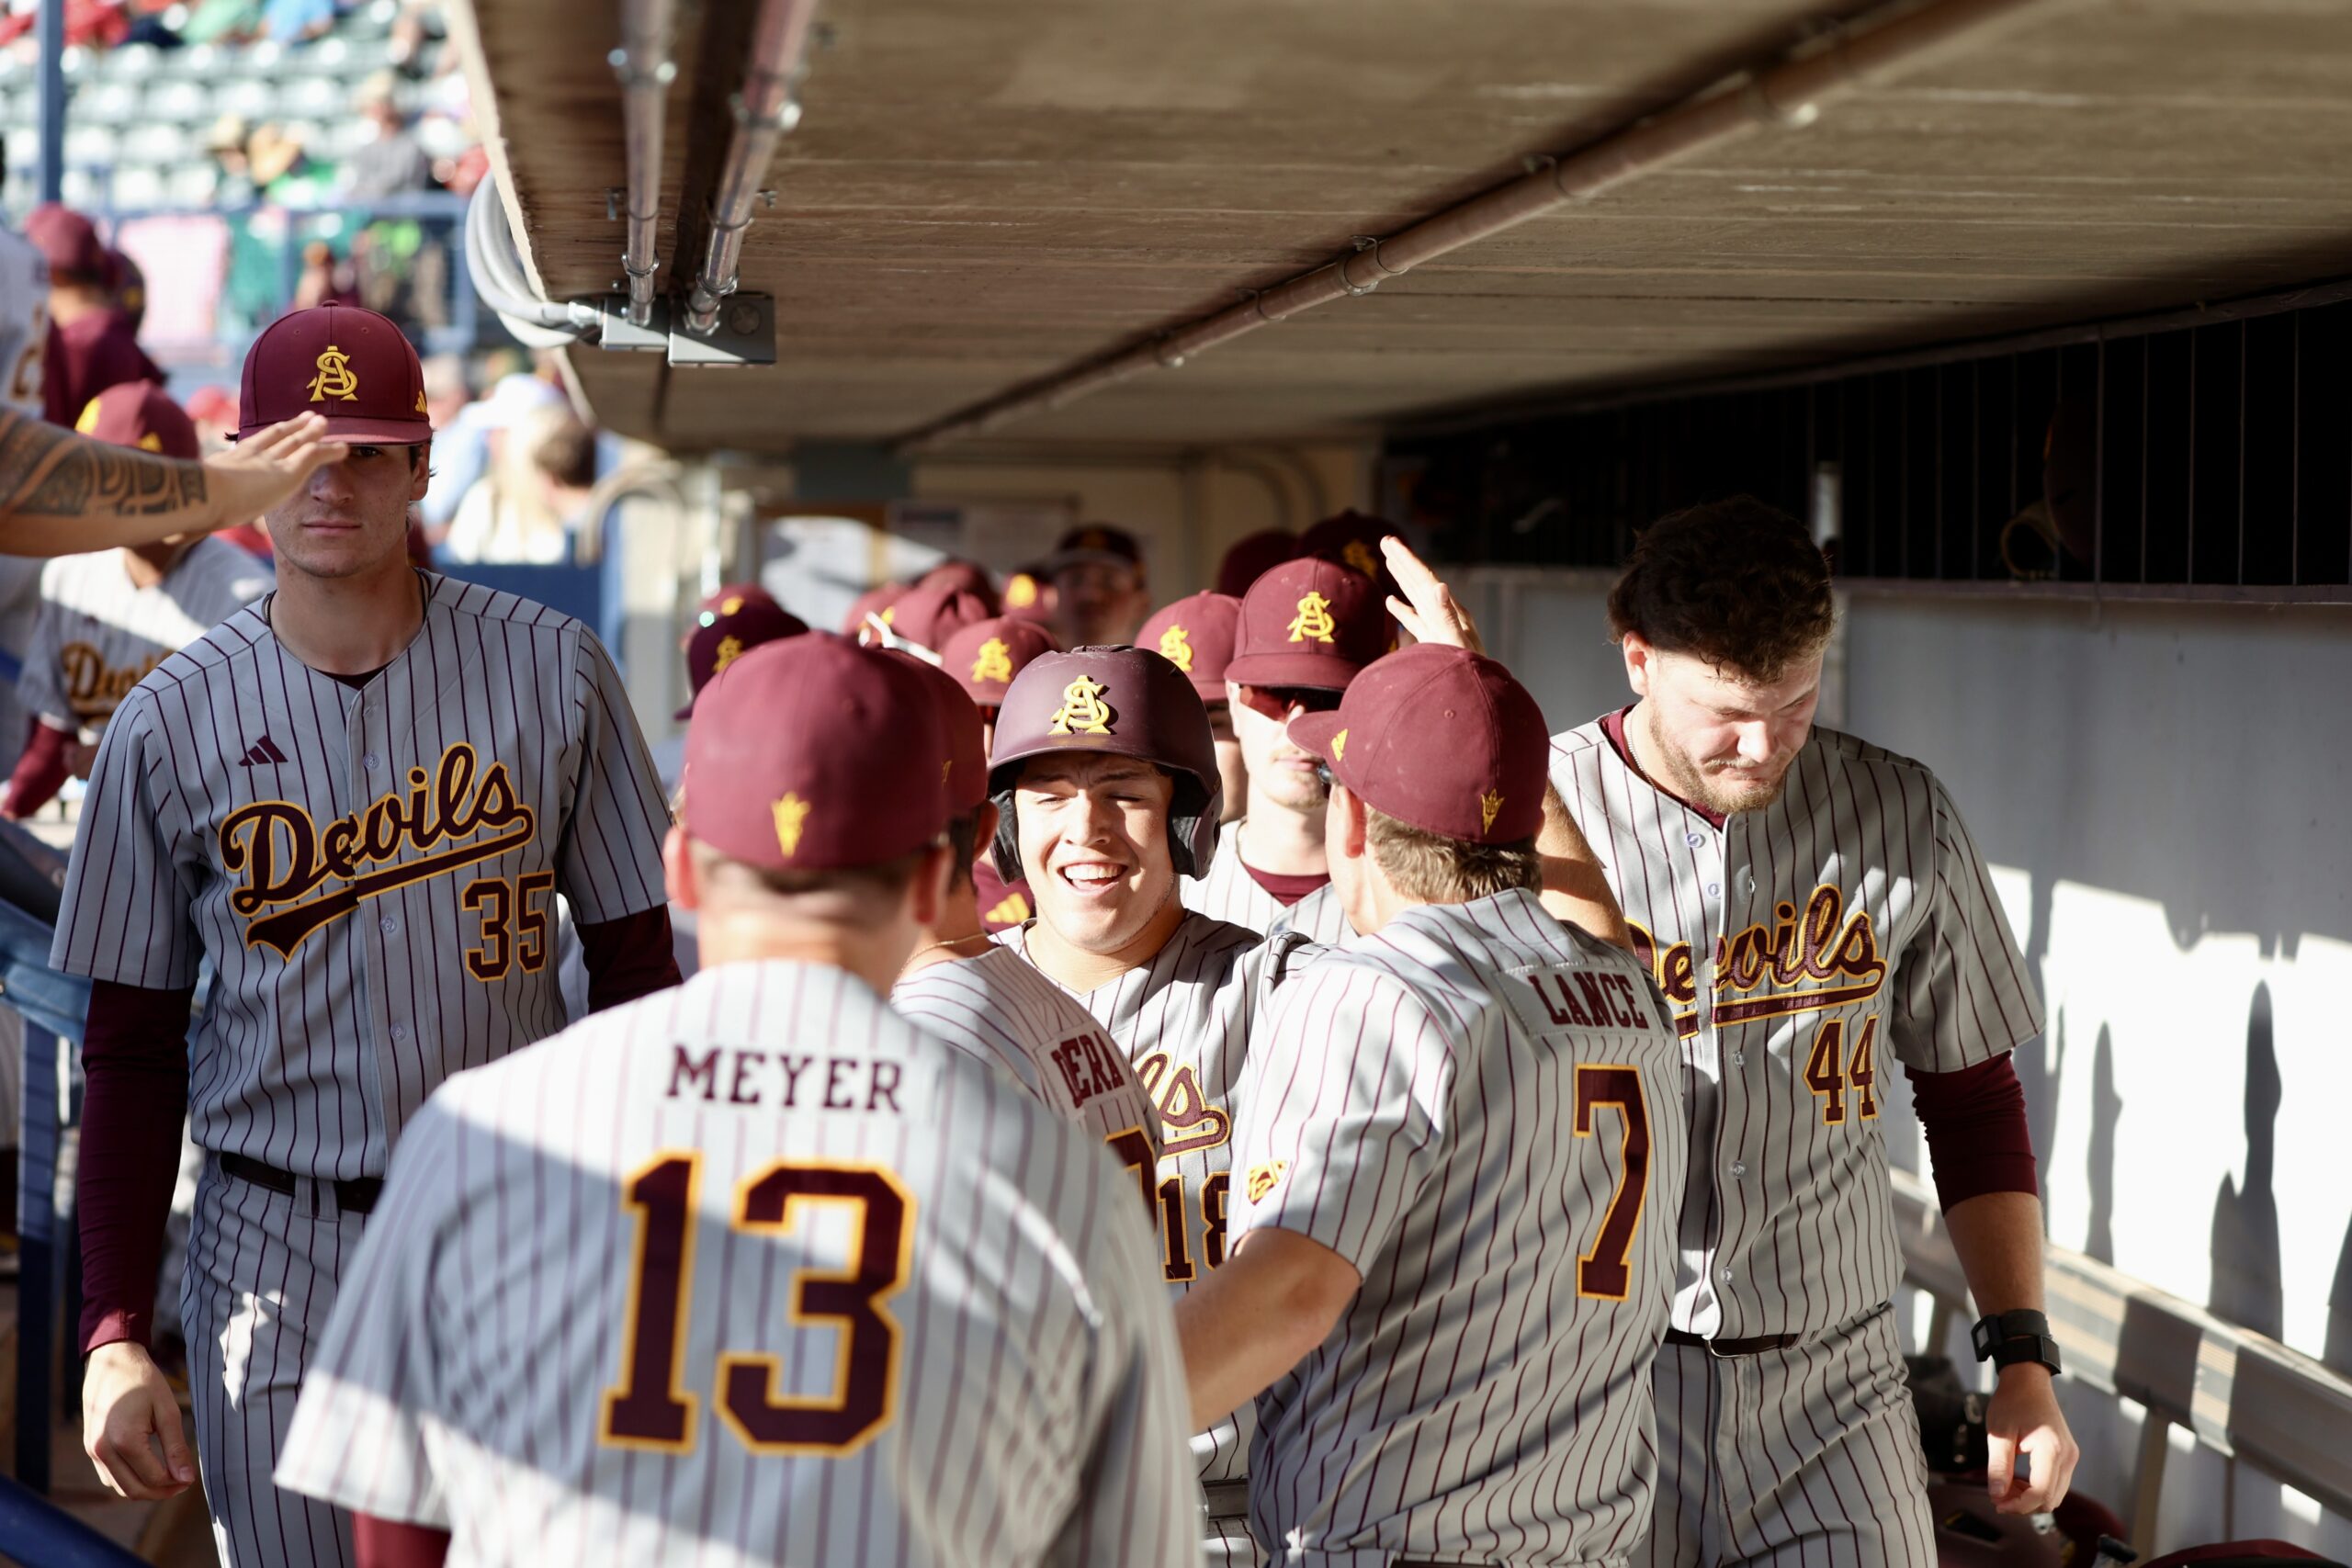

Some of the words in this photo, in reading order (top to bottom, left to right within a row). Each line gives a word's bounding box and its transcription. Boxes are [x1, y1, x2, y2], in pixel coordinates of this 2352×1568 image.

[220, 741, 534, 917] Devils
[461, 869, 555, 983] 35
[1526, 971, 1650, 1031] LANCE
[667, 1043, 903, 1113] MEYER
[1802, 1014, 1879, 1126] 44
[1572, 1062, 1651, 1302] 7
[596, 1147, 919, 1458] 13
